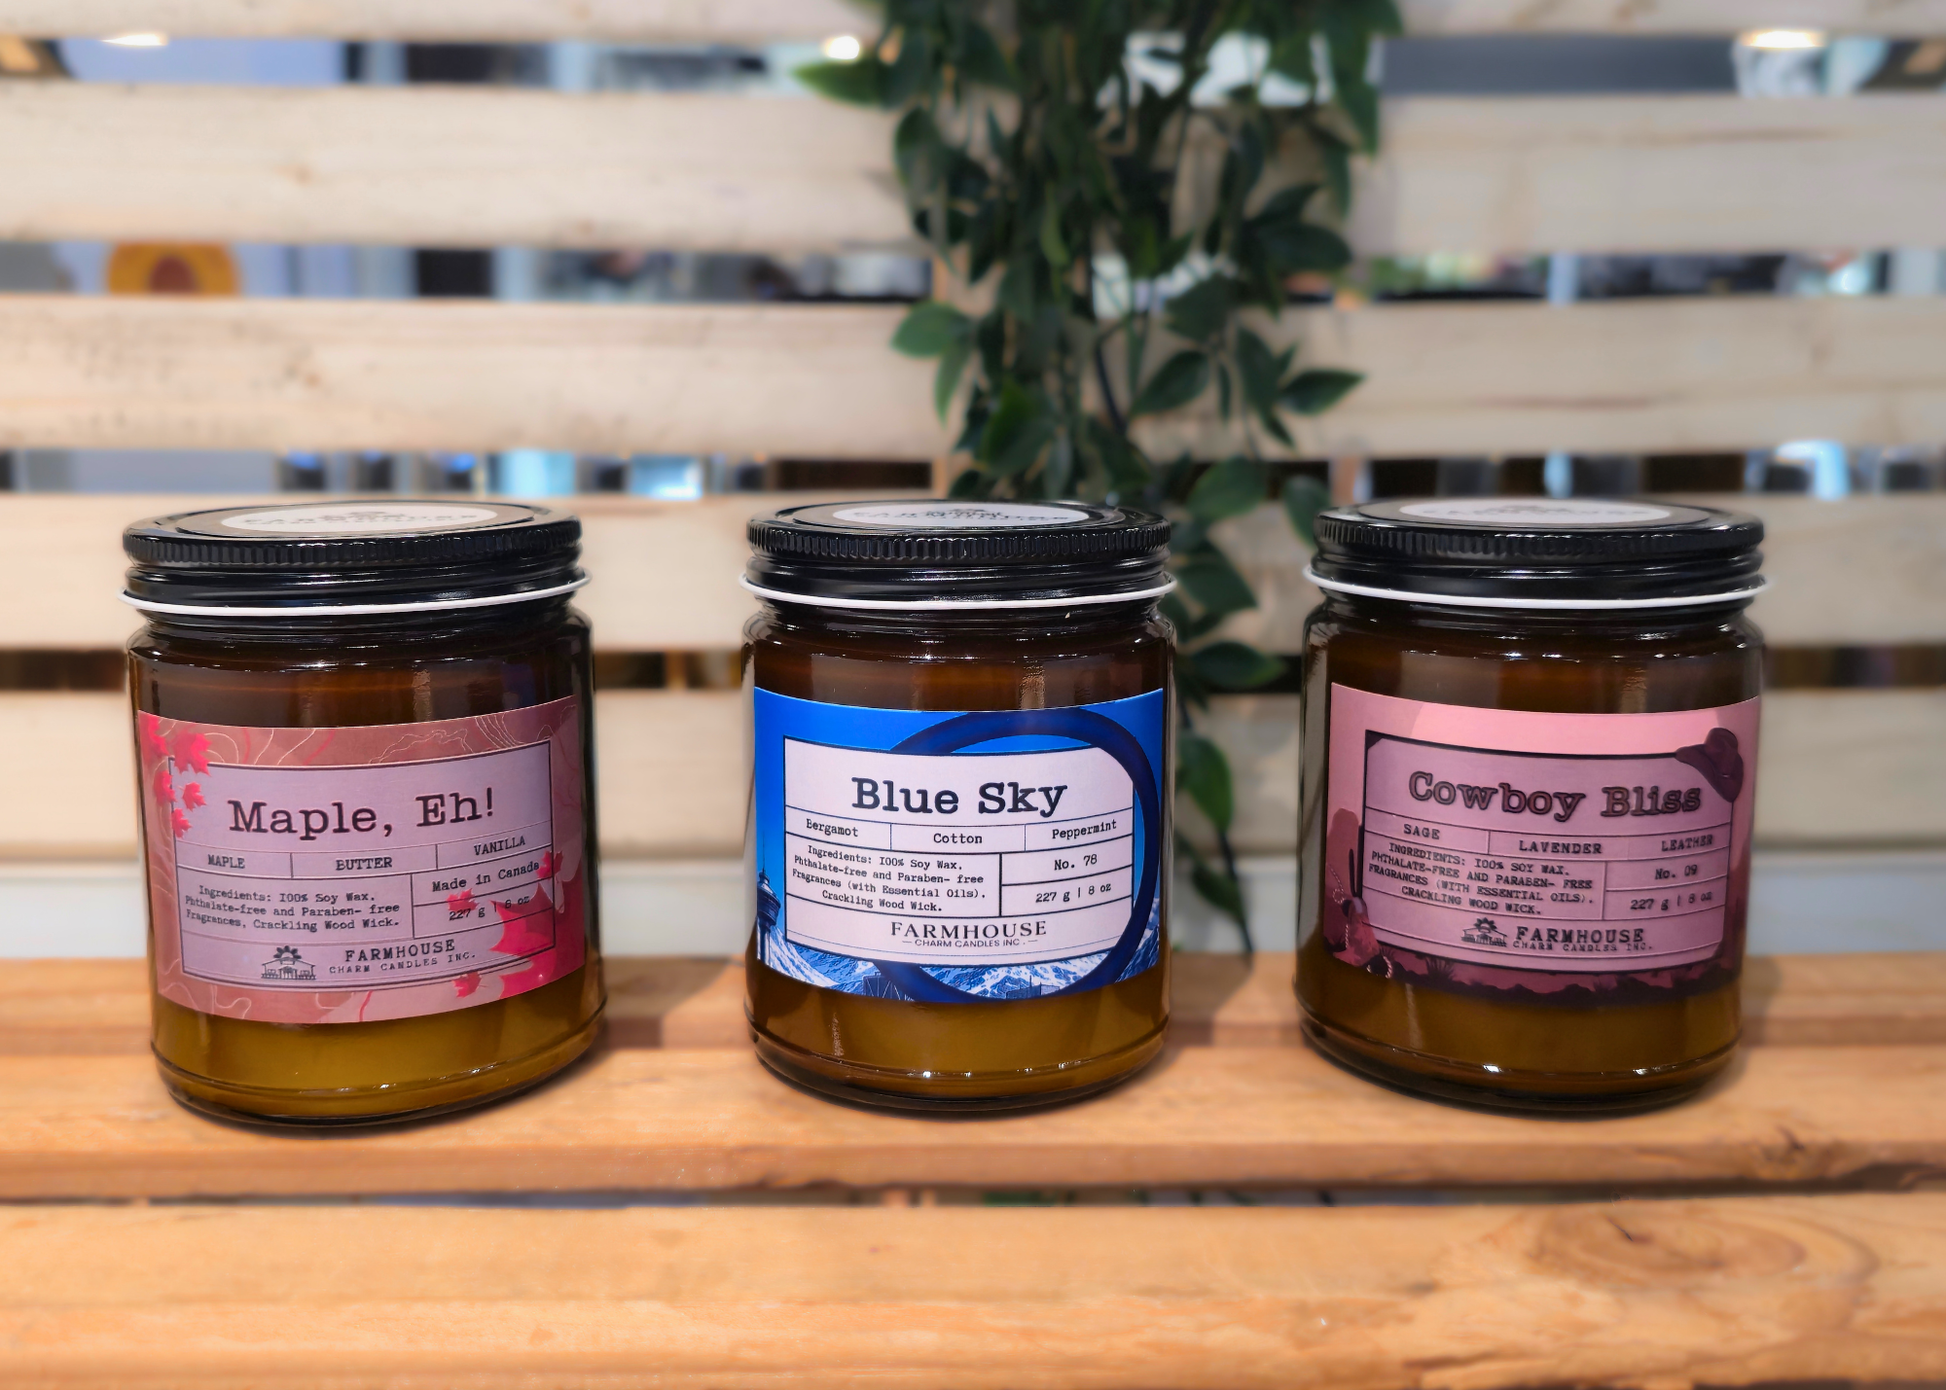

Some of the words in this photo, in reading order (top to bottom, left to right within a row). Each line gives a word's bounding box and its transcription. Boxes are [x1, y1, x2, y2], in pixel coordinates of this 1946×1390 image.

[852, 776, 959, 814] Blue
[978, 782, 1068, 818] Sky
[1408, 771, 1585, 822] Cowboy
[1601, 786, 1701, 818] Bliss
[228, 799, 392, 840] Maple,
[415, 787, 494, 826] Eh!
[806, 819, 858, 837] Bergamot
[933, 833, 982, 844] Cotton
[1052, 819, 1116, 840] Peppermint
[1404, 824, 1440, 840] SAGE
[474, 836, 525, 855] VANILLA
[1519, 840, 1603, 854] LAVENDER
[1662, 834, 1713, 851] LEATHER
[208, 854, 245, 869] MAPLE
[336, 857, 393, 870] BUTTER
[808, 845, 872, 864] Ingredients:
[879, 857, 904, 867] 100%
[910, 859, 930, 870] Soy
[937, 861, 962, 870] Wax.
[1054, 859, 1075, 871] No.
[1084, 854, 1098, 866] 78
[1389, 842, 1466, 865] INGREDIENTS:
[1511, 863, 1533, 873] SOY
[1541, 865, 1569, 876] WAX.
[432, 879, 467, 891] Made
[476, 874, 490, 884] in
[498, 861, 539, 879] Canada
[794, 855, 867, 877] Phthalate-free
[873, 871, 892, 880] and
[898, 873, 950, 883] Paraben-
[957, 874, 984, 884] free
[1372, 851, 1459, 878] PHTHALATE-FREE
[1467, 872, 1488, 882] AND
[1563, 880, 1592, 889] FREE
[1655, 868, 1676, 880] No.
[1684, 864, 1697, 876] 09
[199, 885, 271, 902] Ingredients:
[279, 893, 308, 902] 100%
[315, 893, 338, 904] Soy
[346, 893, 374, 901] Wax.
[793, 869, 841, 887] Fragrances
[848, 880, 876, 893] (with
[882, 886, 939, 898] Essential
[947, 889, 985, 899] Oils).
[1036, 892, 1057, 903] 227
[1063, 891, 1070, 901] g
[1088, 886, 1094, 895] 8
[1100, 883, 1111, 892] oz
[1369, 864, 1428, 885] FRAGRANCES
[1436, 880, 1469, 892] (WITH
[1477, 886, 1543, 901] ESSENTIAL
[1551, 893, 1593, 904] OILS).
[185, 895, 267, 915] Phthalate-free
[274, 907, 294, 916] and
[302, 907, 361, 916] Paraben-
[369, 904, 399, 914] free
[449, 909, 471, 921] 227
[478, 907, 485, 918] g
[505, 899, 511, 908] 8
[518, 896, 530, 905] oz
[822, 891, 873, 908] Crackling
[879, 899, 904, 910] Wood
[911, 902, 942, 912] Wick.
[1402, 886, 1462, 905] CRACKLING
[1469, 898, 1498, 910] WOOD
[1505, 902, 1541, 914] WICK.
[1630, 899, 1654, 910] 227
[1661, 899, 1669, 911] g
[1689, 894, 1695, 903] 8
[187, 909, 246, 928] Fragrances,
[253, 919, 317, 932] Crackling
[325, 920, 355, 929] Wood
[363, 918, 399, 928] Wick.
[891, 921, 1047, 940] FARMHOUSE
[915, 939, 951, 947] CHARM
[955, 939, 1000, 947] CANDLES
[1516, 926, 1644, 943] FARMHOUSE
[345, 939, 455, 962] FARMHOUSE
[1513, 941, 1552, 950] CHARM
[1563, 944, 1617, 952] CANDLES
[1626, 942, 1652, 951] INC.
[330, 964, 370, 974] CHARM
[381, 958, 438, 971] CANDLES
[448, 952, 476, 963] INC.
